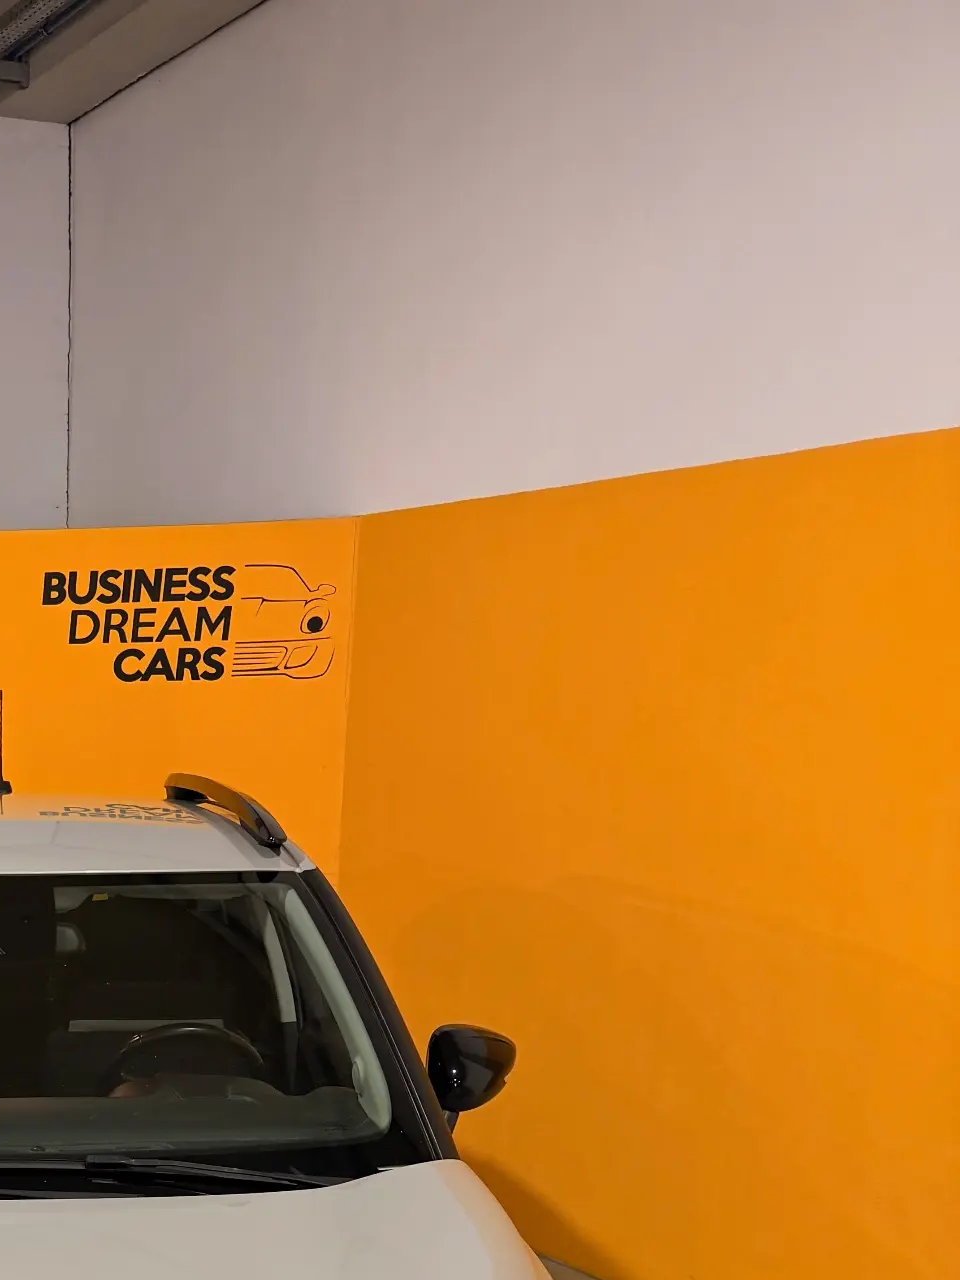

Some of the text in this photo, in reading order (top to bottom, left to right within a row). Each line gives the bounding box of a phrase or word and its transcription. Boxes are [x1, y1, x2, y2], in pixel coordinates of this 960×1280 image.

[42, 566, 236, 605] BUSINESS
[68, 606, 233, 644] DREAM
[113, 647, 226, 682] CARS
